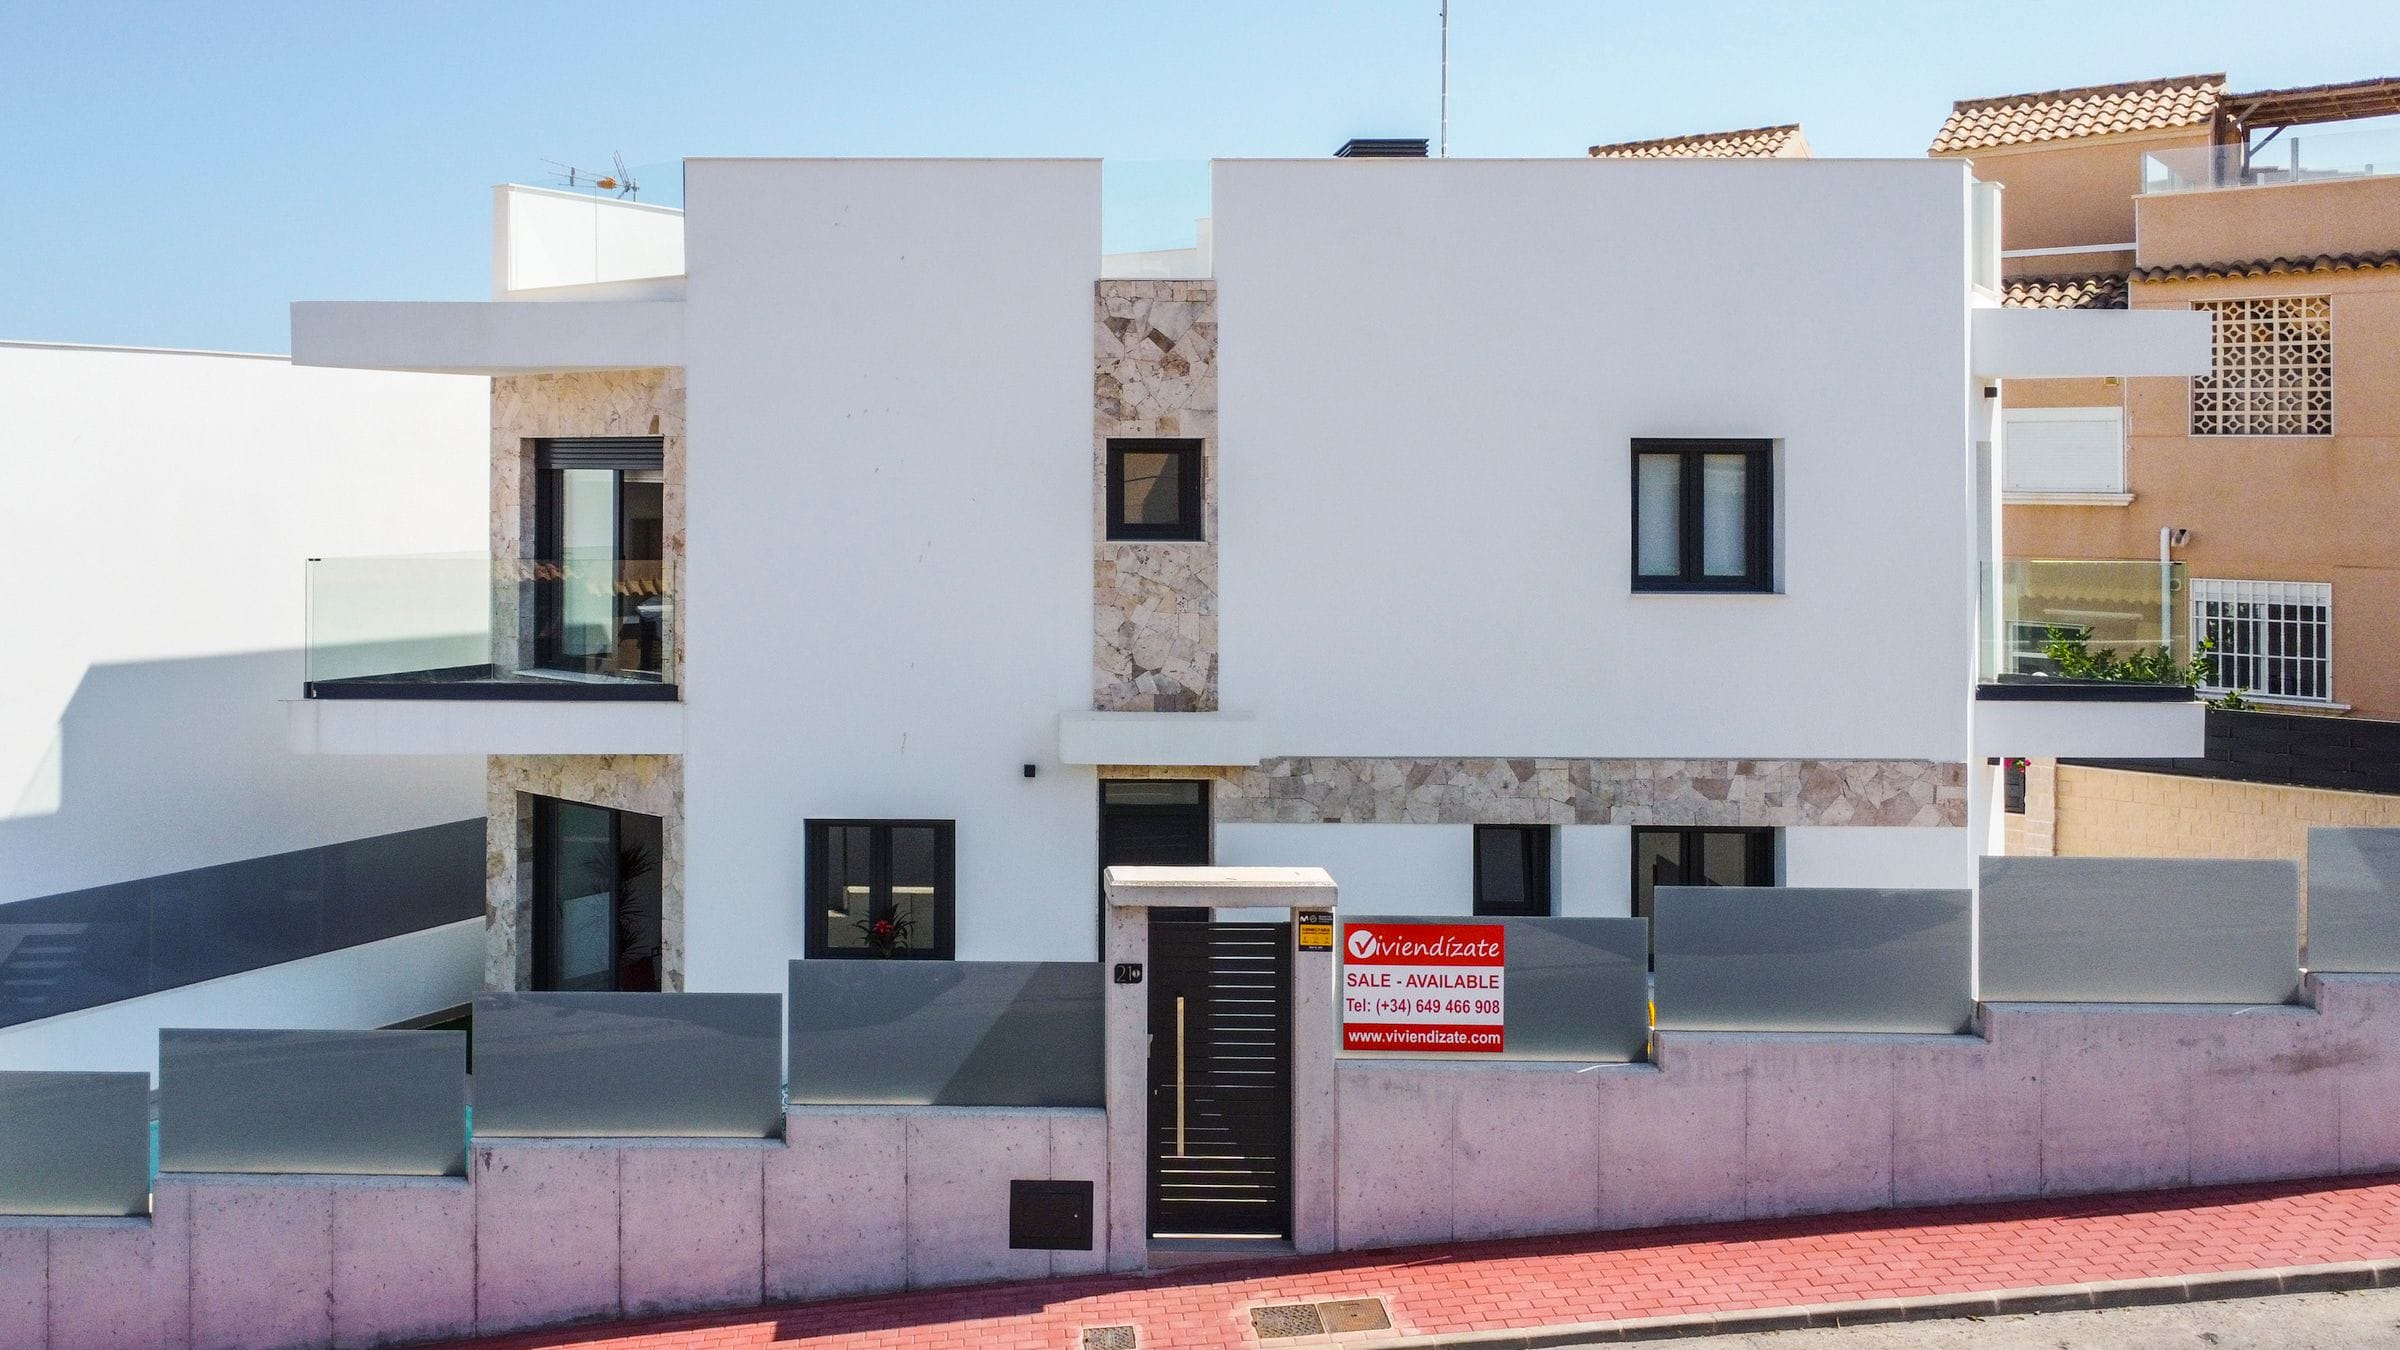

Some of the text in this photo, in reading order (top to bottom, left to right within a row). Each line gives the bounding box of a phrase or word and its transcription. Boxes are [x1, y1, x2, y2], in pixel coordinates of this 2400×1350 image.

[1347, 973, 1391, 988] SALE
[1406, 974, 1500, 989] AVAILABLE
[1346, 998, 1500, 1016] Tel: (+34) 649 466 908
[1348, 1029, 1501, 1044] www.viviendizate.com
